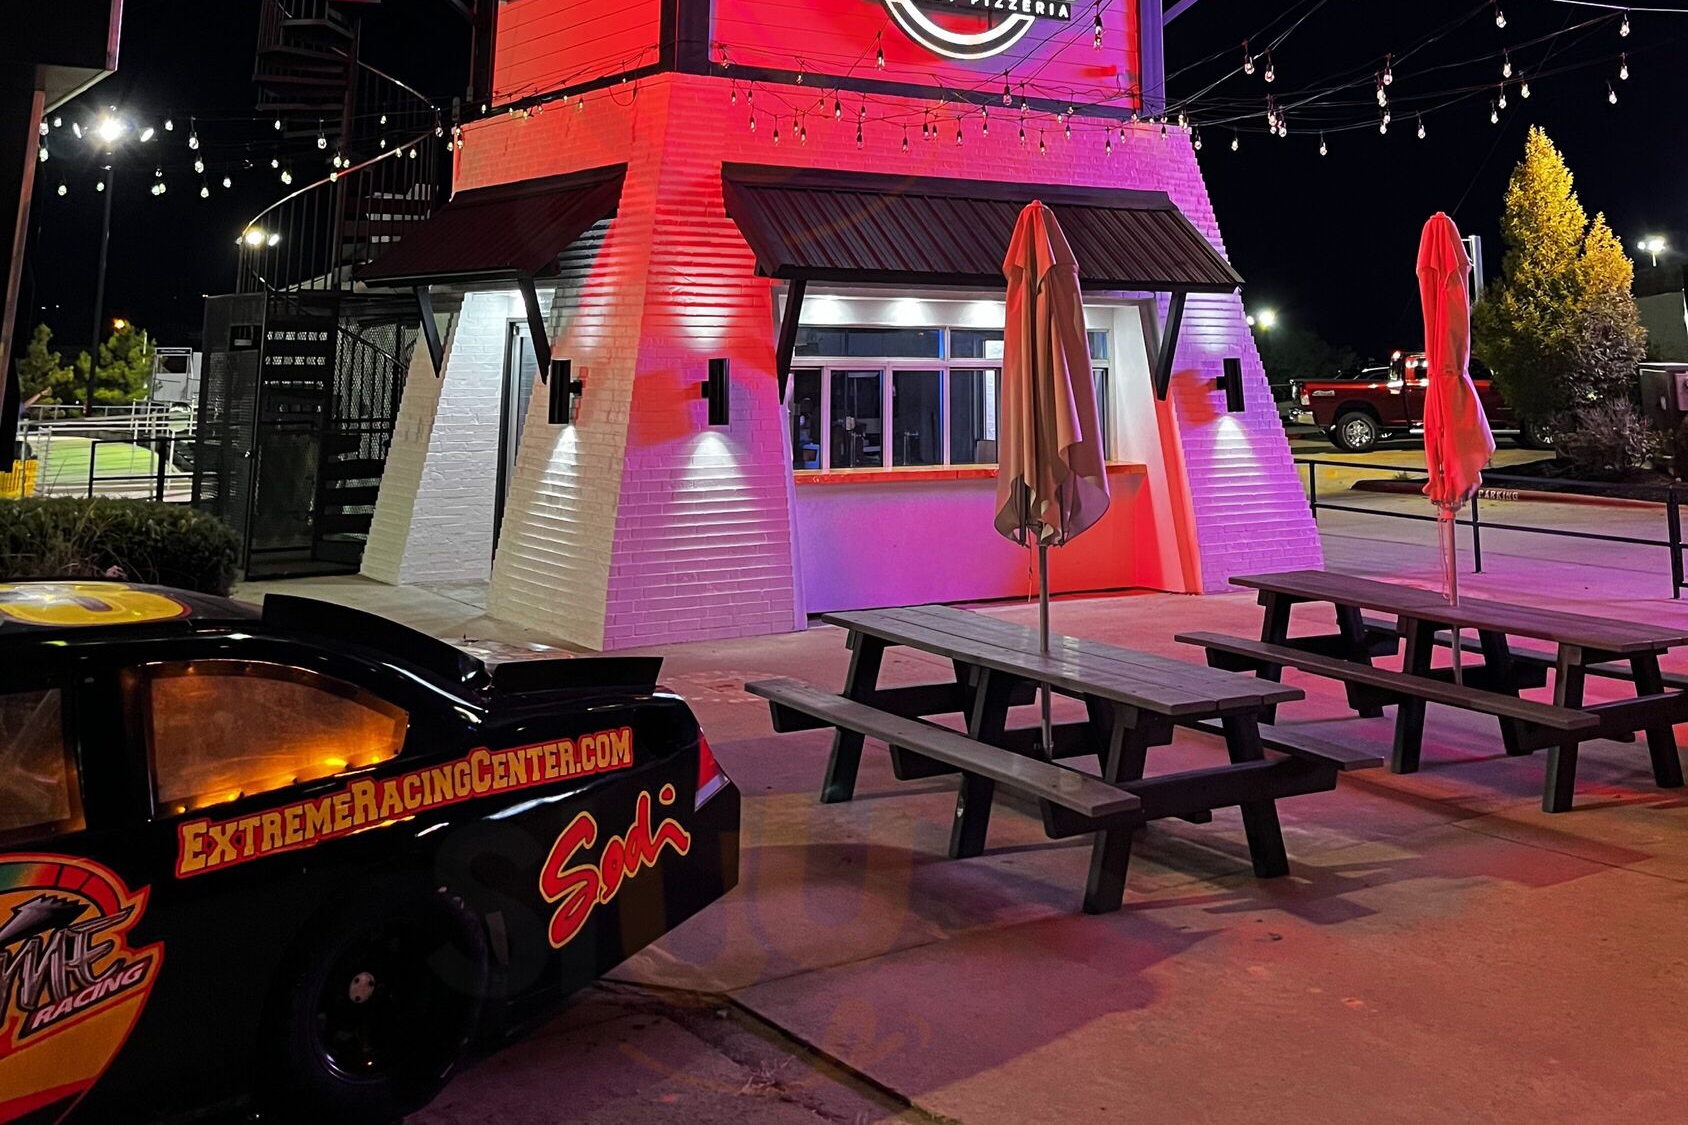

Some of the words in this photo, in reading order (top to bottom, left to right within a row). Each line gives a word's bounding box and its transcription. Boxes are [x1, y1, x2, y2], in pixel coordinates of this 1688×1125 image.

[1478, 489, 1519, 501] PARKING
[539, 783, 691, 949] Sodi
[31, 961, 146, 1030] RACING
